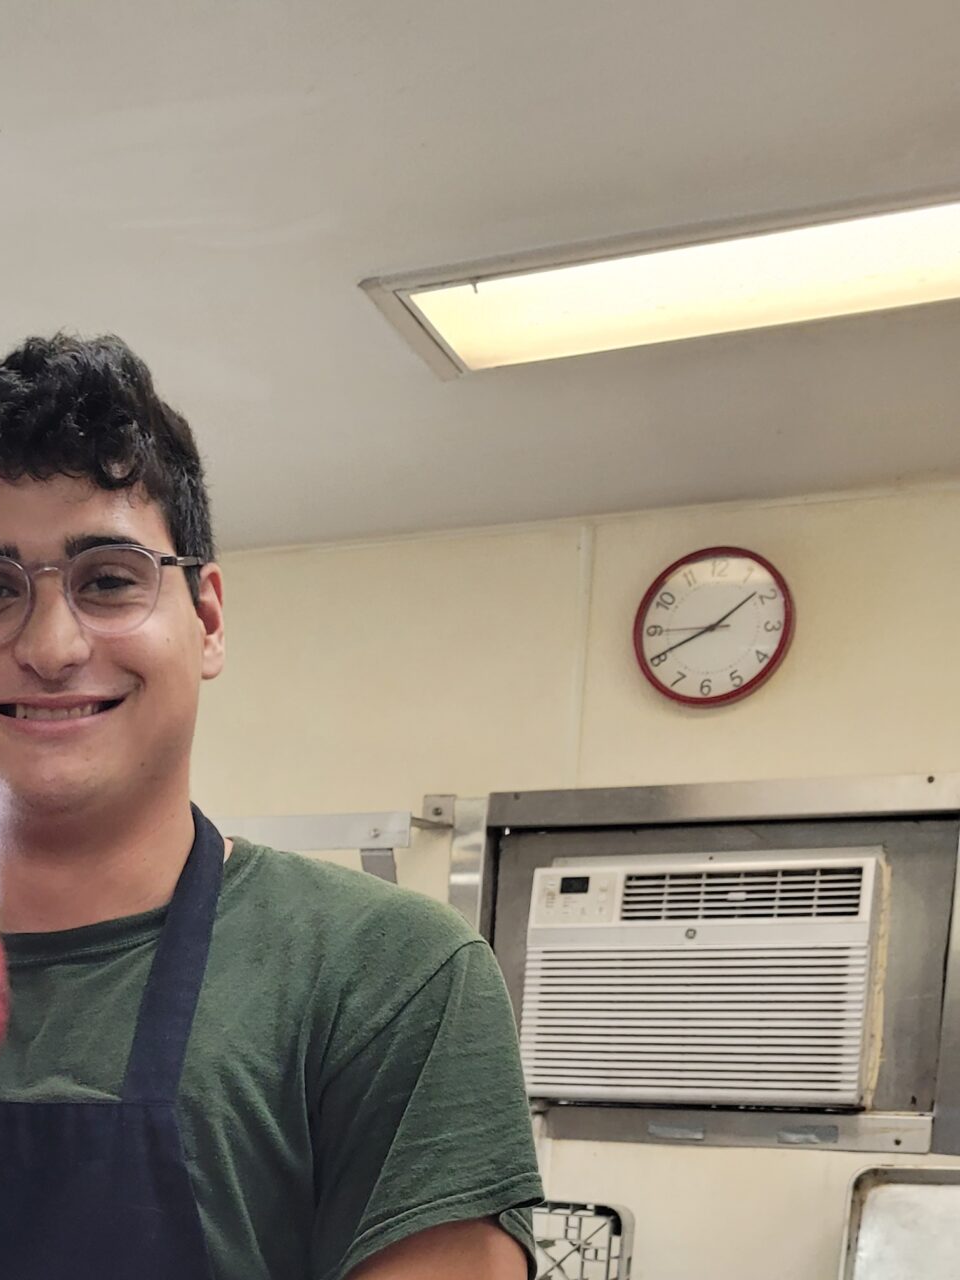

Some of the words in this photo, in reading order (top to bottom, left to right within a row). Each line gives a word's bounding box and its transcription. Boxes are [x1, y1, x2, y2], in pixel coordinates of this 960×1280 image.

[711, 559, 729, 578] 12
[743, 567, 755, 584] 1
[683, 570, 697, 588] 11
[655, 591, 676, 611] 10
[758, 588, 778, 605] 2
[646, 624, 663, 637] 9
[764, 620, 782, 633] 3
[754, 648, 769, 664] 4
[670, 671, 687, 687] 7
[729, 669, 744, 688] 5
[699, 678, 712, 697] 6
